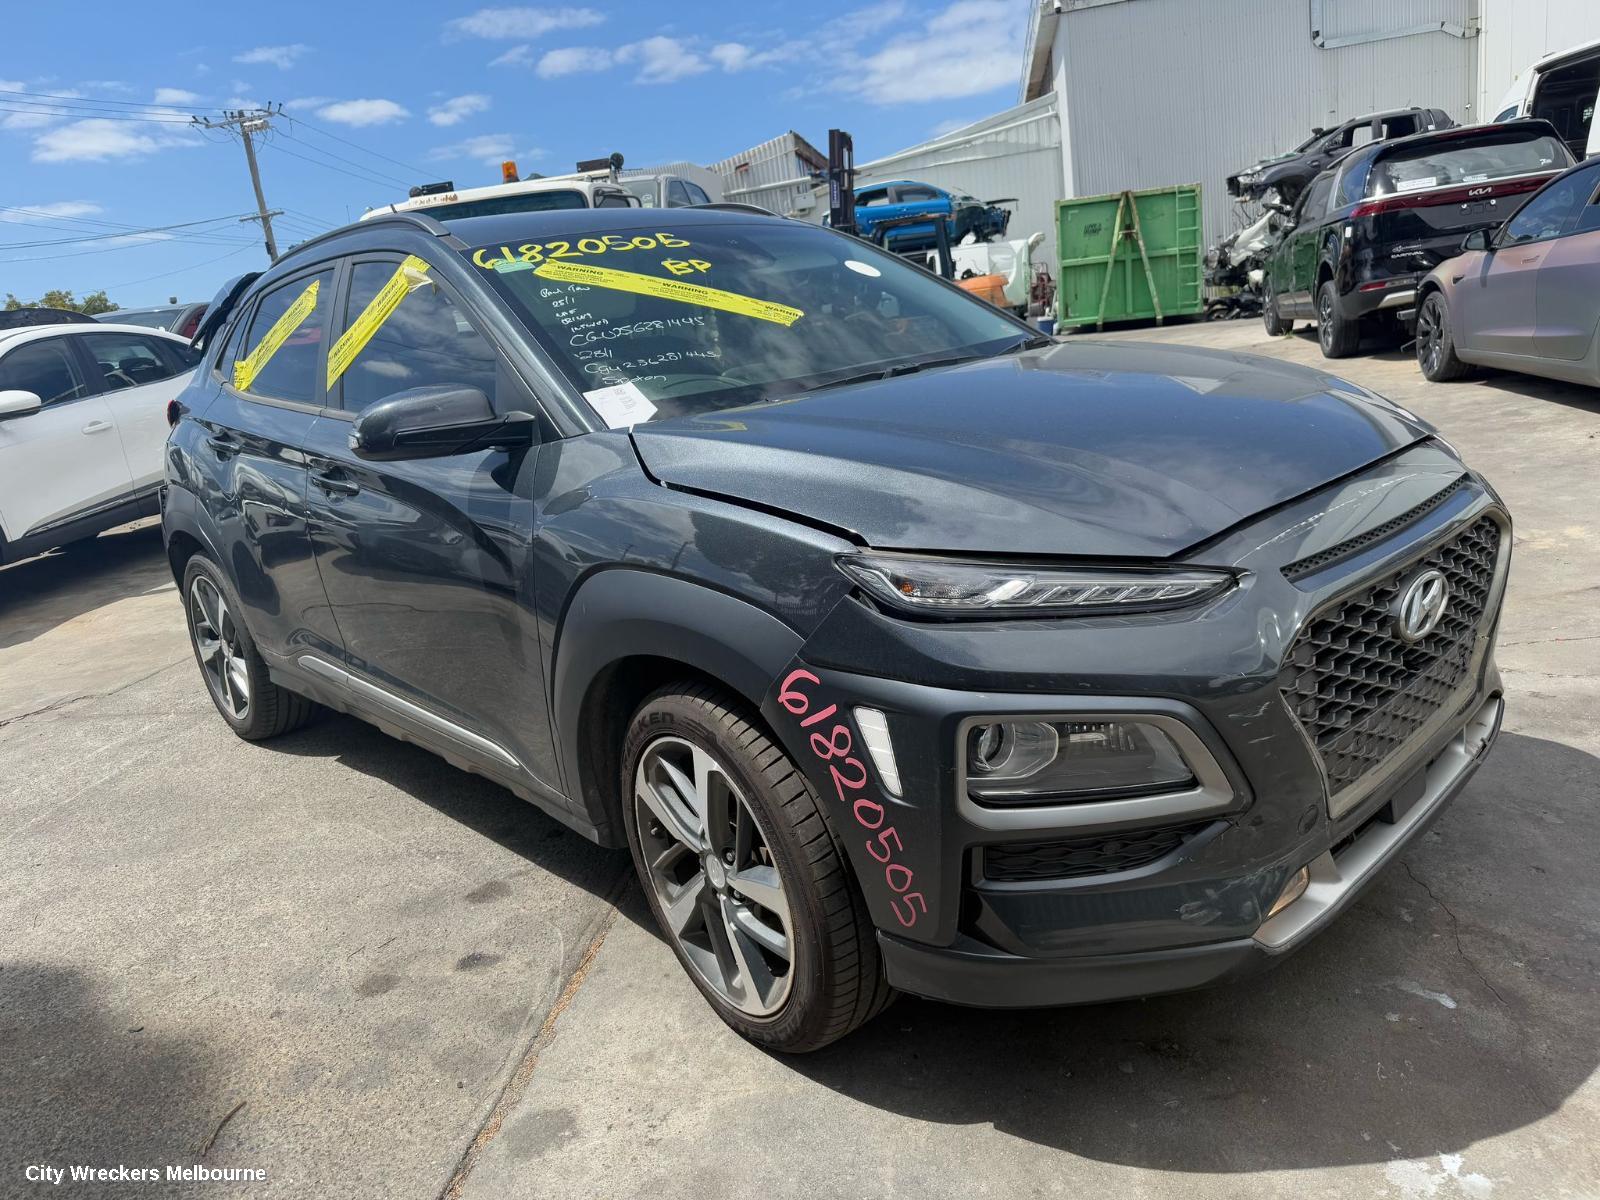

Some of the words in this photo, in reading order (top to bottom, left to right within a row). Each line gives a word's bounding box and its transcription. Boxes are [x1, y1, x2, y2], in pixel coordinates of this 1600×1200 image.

[472, 232, 690, 269] 61820505
[557, 264, 604, 275] WARNING
[662, 282, 708, 295] WARNING
[777, 668, 928, 928] 61820505
